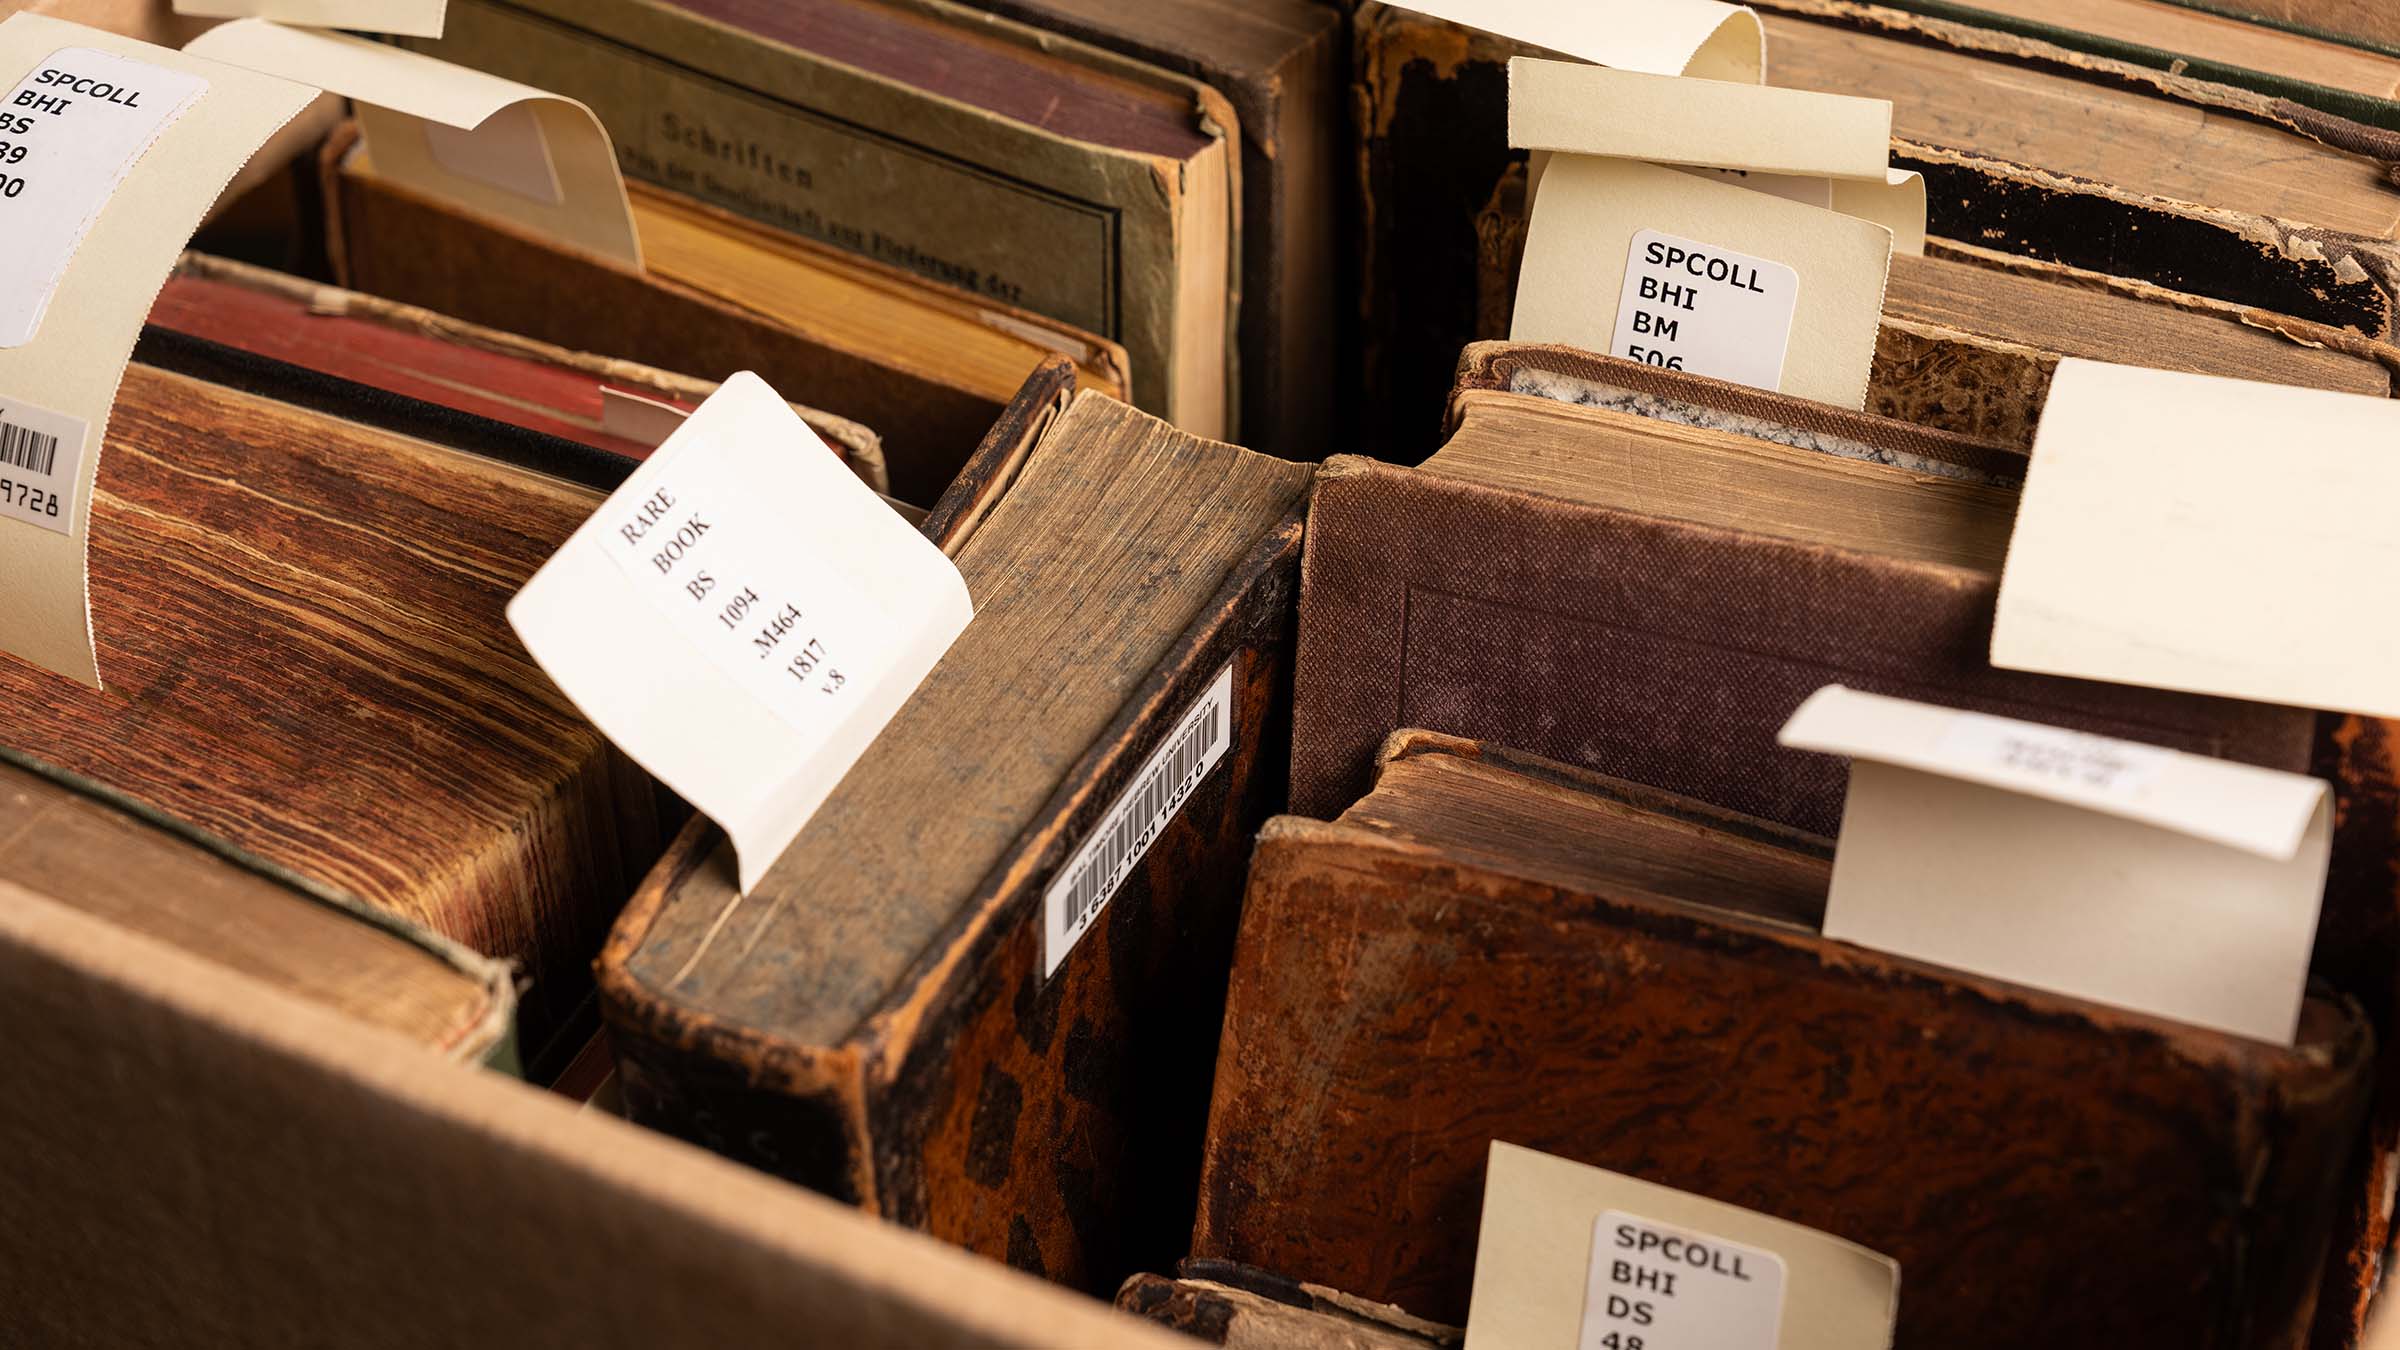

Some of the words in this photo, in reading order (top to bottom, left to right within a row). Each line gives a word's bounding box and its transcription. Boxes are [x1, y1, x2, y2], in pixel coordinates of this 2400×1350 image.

[13, 89, 72, 116] BHI
[35, 69, 140, 107] SPCOLL
[660, 111, 813, 190] Schriften
[1645, 242, 1765, 293] SPCOLL
[1639, 276, 1698, 311] BHI
[1632, 310, 1679, 342] BM
[620, 487, 676, 546] RARE
[652, 513, 711, 575] BOOK
[686, 569, 717, 602] BS
[718, 585, 760, 631] 1094
[787, 637, 828, 682] 1817
[821, 668, 846, 695] v.8
[1123, 764, 1160, 817] HEBREW
[1161, 697, 1214, 766] UNIVERSITY
[1078, 913, 1087, 930] 3
[1090, 867, 1122, 915] 6387
[1126, 825, 1156, 867] 1001
[1160, 775, 1193, 821] 1432
[1195, 760, 1204, 778] 0
[1615, 1225, 1751, 1281] SPCOLL
[1611, 1260, 1678, 1297] BHI
[1606, 1295, 1654, 1326] DS
